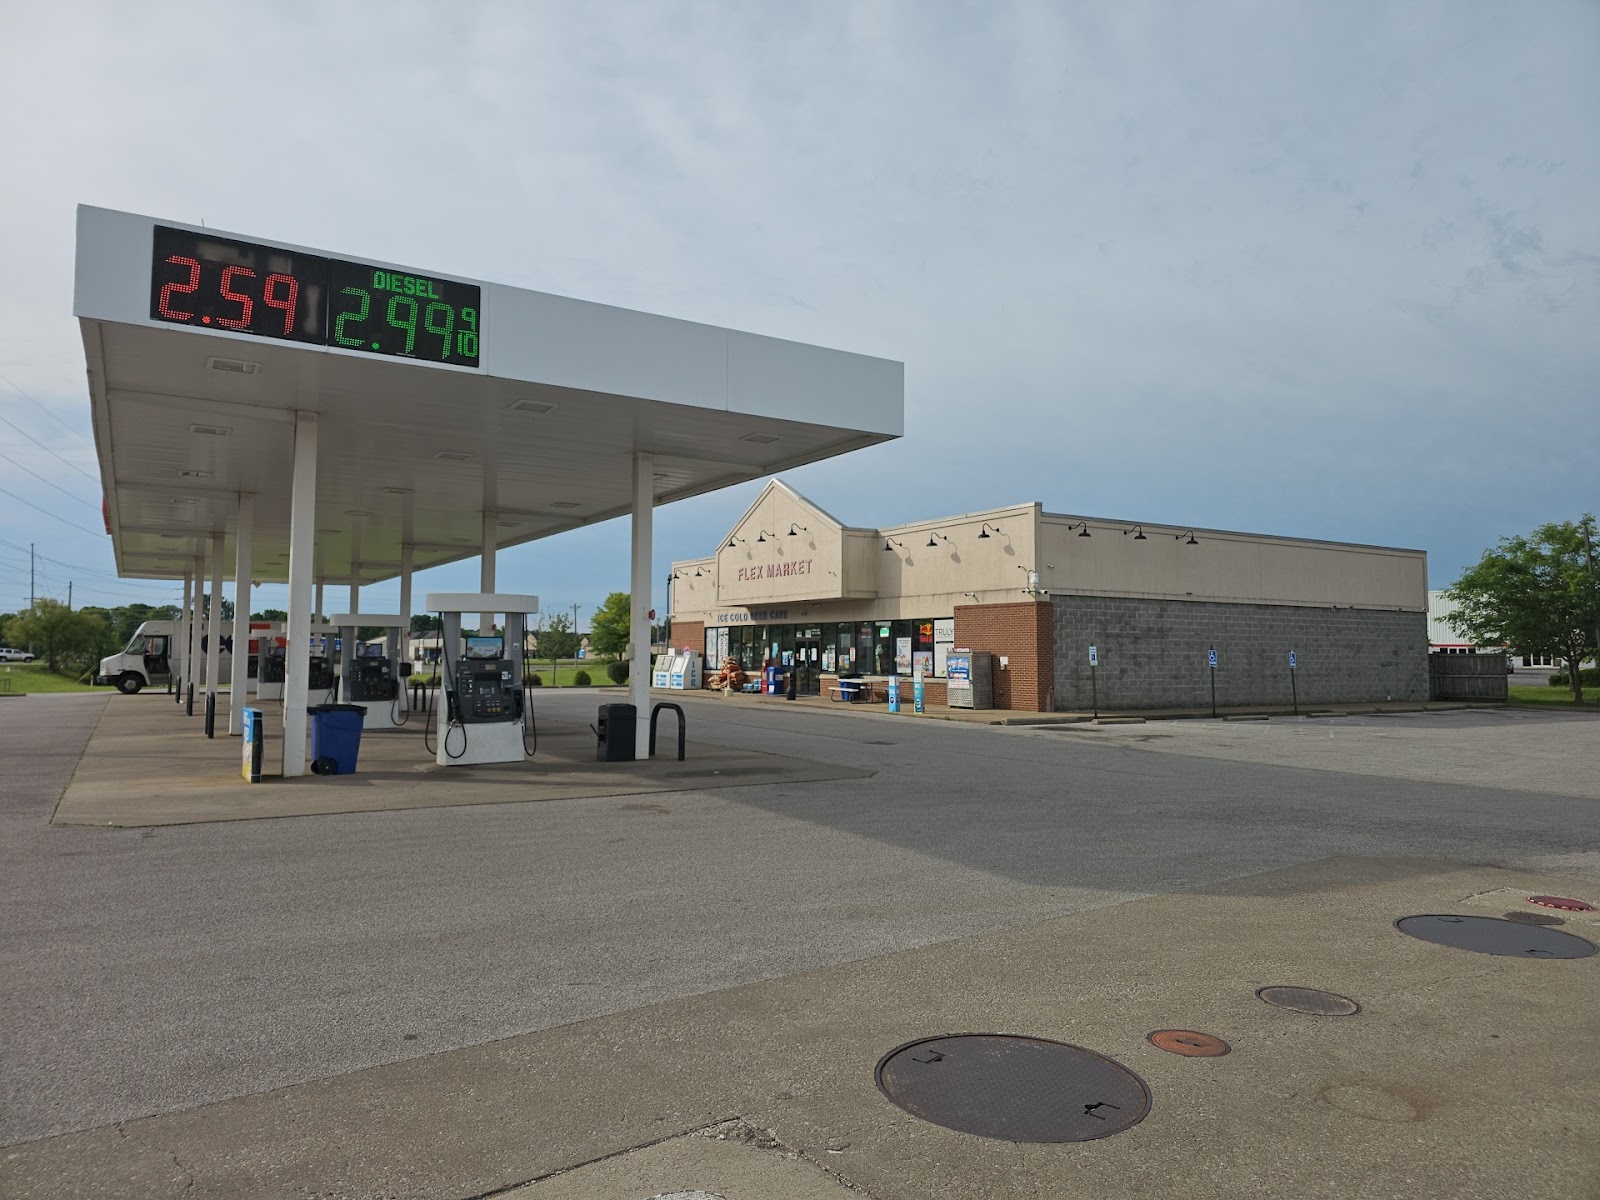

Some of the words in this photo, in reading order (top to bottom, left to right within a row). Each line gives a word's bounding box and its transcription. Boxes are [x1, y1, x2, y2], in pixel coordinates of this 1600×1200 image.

[159, 255, 299, 336] 2.59
[373, 271, 439, 299] DIESEL
[334, 286, 455, 359] 2.99
[738, 566, 763, 581] FLEX
[767, 559, 812, 578] MARKET
[717, 613, 728, 623] ICE
[730, 613, 748, 622] COLD
[750, 611, 768, 621] BEER
[769, 610, 788, 620] CAVE
[935, 628, 954, 636] TRULY
